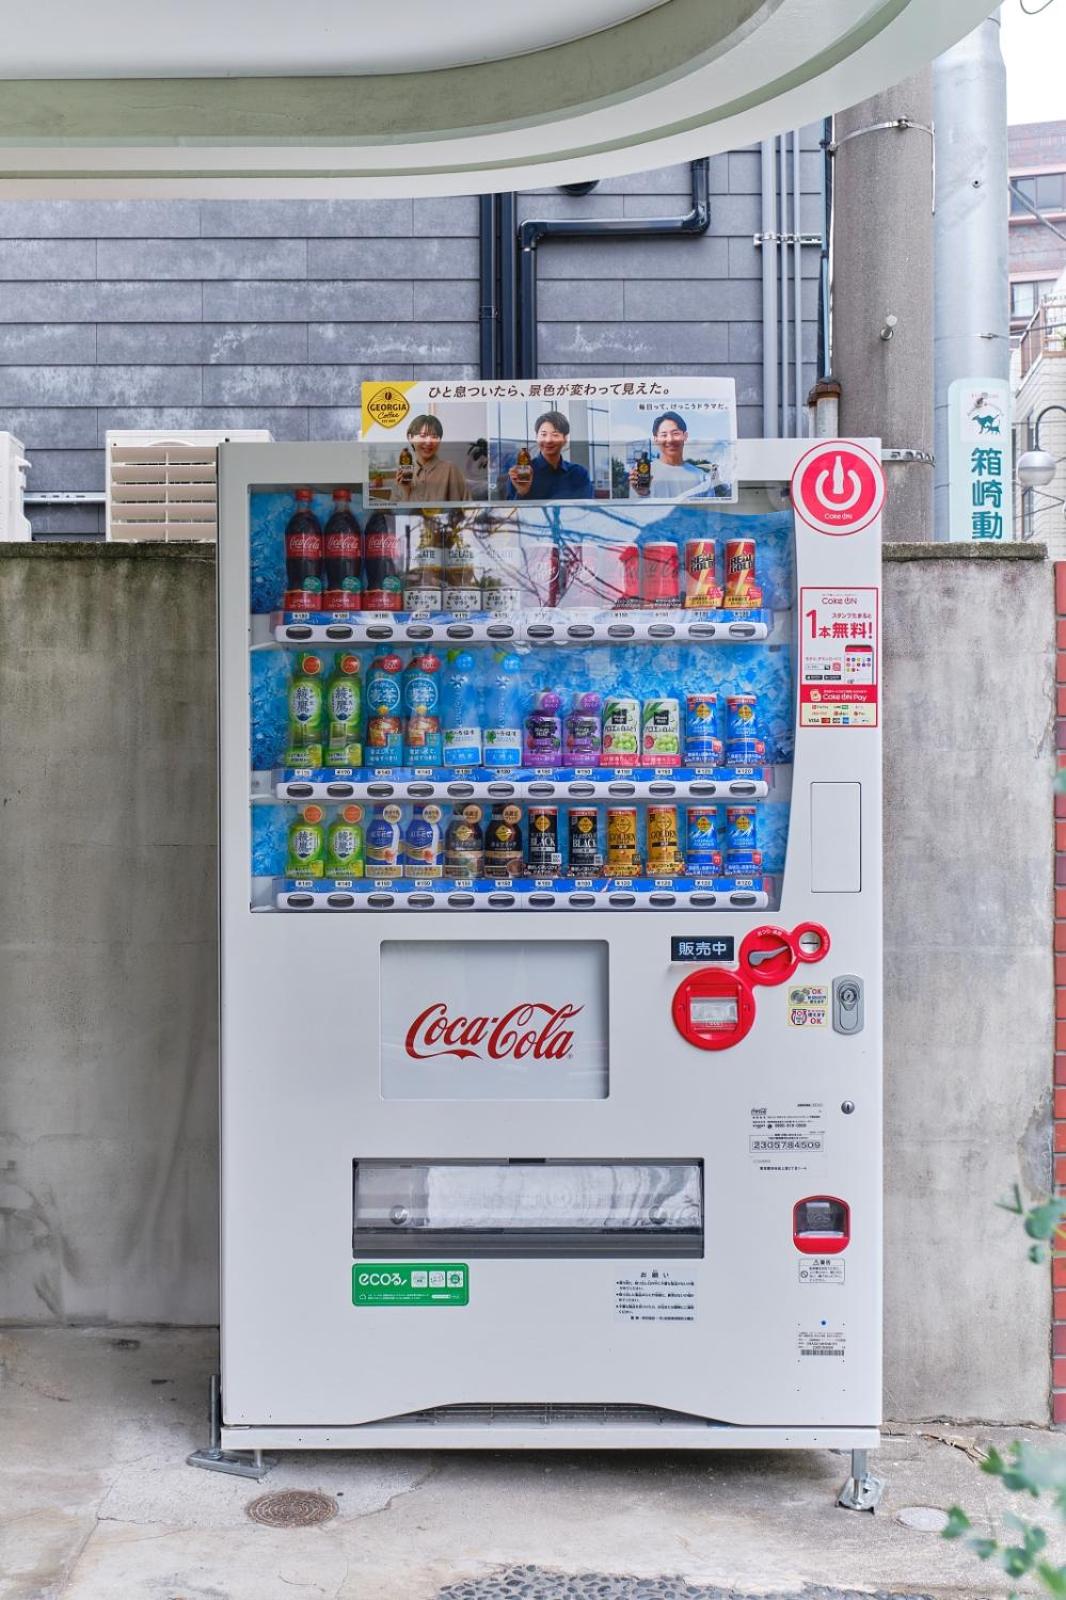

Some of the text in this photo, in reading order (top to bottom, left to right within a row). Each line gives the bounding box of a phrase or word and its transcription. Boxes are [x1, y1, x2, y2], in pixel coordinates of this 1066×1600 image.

[428, 382, 670, 398] ひと息ついたら、景色が変わって見えた。
[370, 404, 407, 412] GEORGIA
[378, 411, 400, 419] Coffee
[971, 447, 1003, 540] 箱崎動
[531, 837, 555, 846] BLACK
[572, 838, 596, 848] BLACK
[679, 941, 727, 956] 販売中
[405, 1003, 585, 1060] Coca-Cola
[753, 1141, 820, 1149] 2305784509
